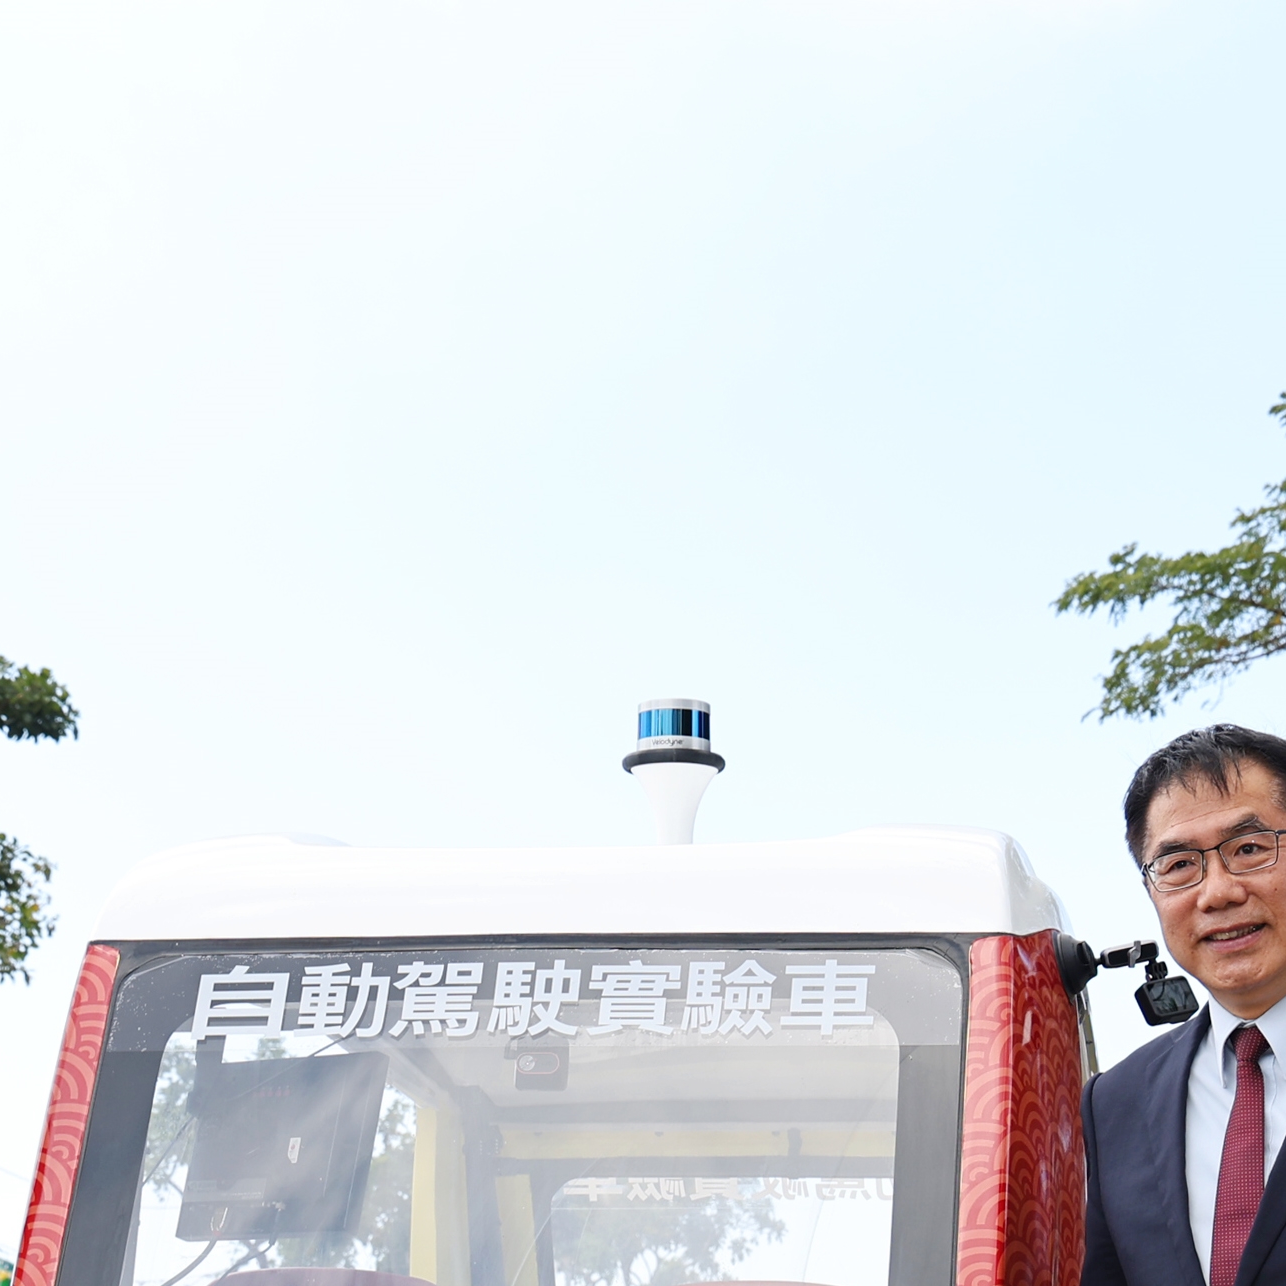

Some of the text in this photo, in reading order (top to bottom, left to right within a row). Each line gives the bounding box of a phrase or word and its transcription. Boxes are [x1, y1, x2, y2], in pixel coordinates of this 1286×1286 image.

[651, 738, 683, 746] Velodyne
[190, 958, 876, 1042] 自動駕駛實驗車
